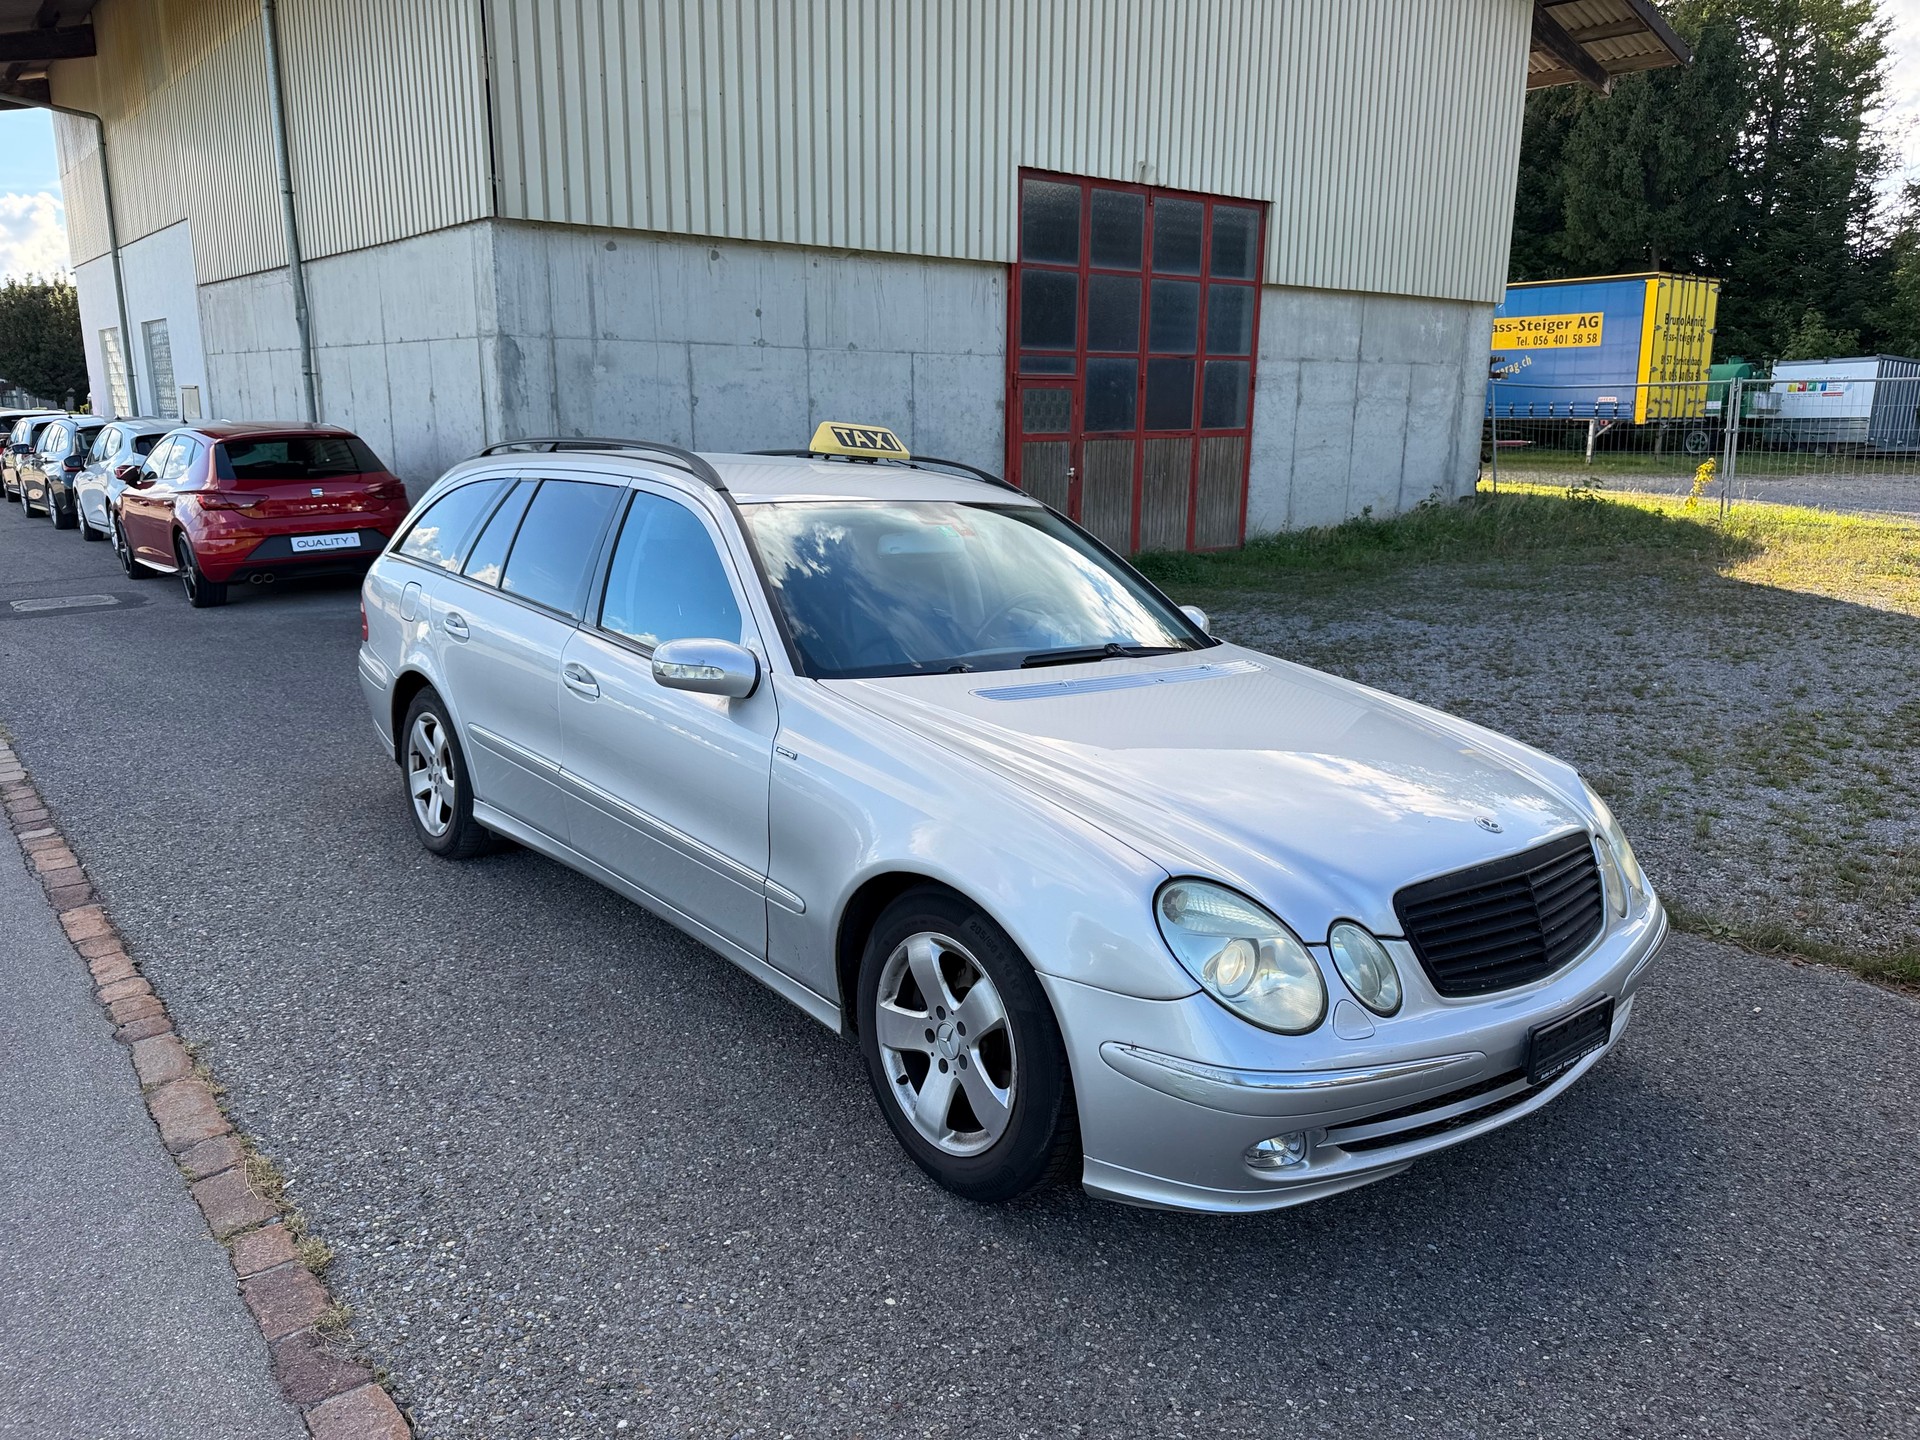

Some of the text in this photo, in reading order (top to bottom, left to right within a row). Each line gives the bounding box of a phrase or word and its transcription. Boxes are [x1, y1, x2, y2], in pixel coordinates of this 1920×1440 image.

[1492, 315, 1599, 334] ass-Steiger AG
[1516, 333, 1598, 346] Tel. 056 401 58 58
[832, 428, 900, 450] TAXI
